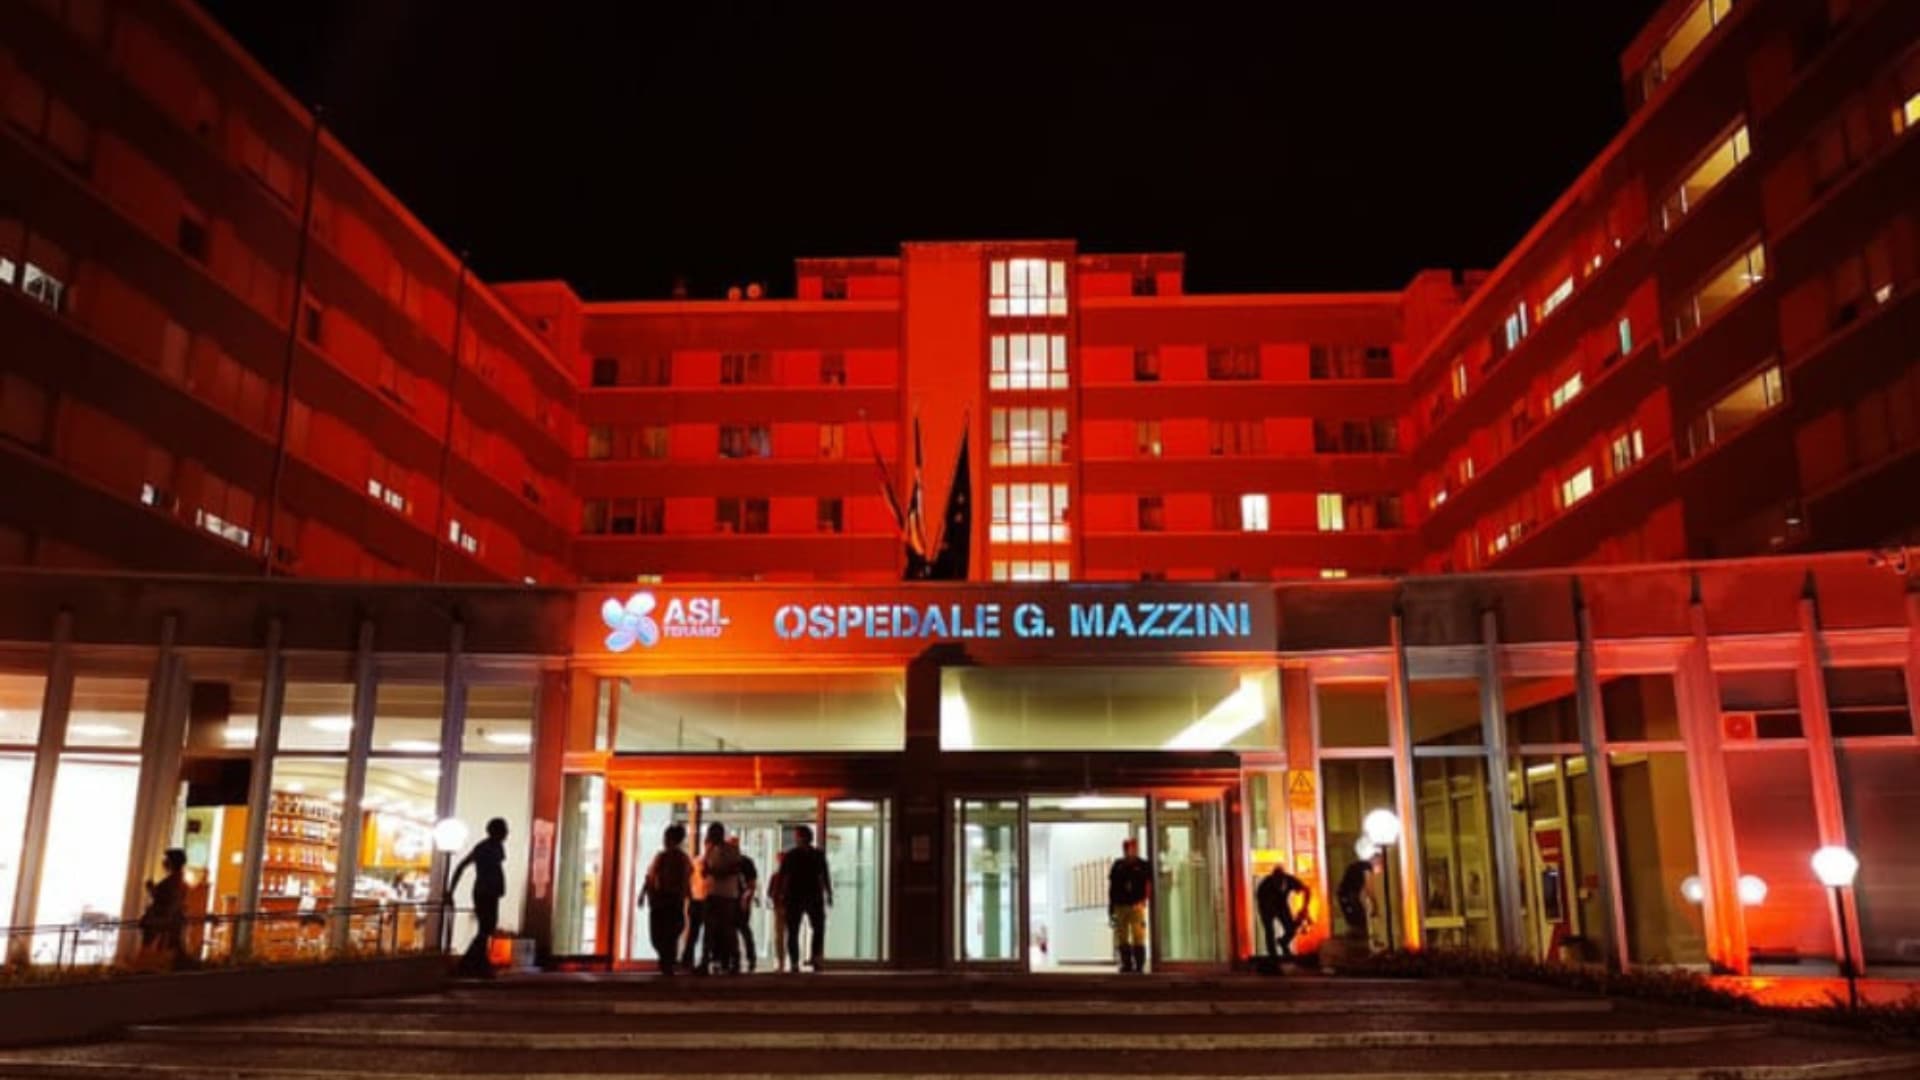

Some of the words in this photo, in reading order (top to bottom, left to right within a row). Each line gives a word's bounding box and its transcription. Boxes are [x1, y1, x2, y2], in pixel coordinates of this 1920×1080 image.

[664, 597, 730, 625] ASL
[774, 603, 1000, 639] OSPEDALE
[1013, 602, 1055, 638] G.
[1070, 602, 1250, 637] MAZZINI
